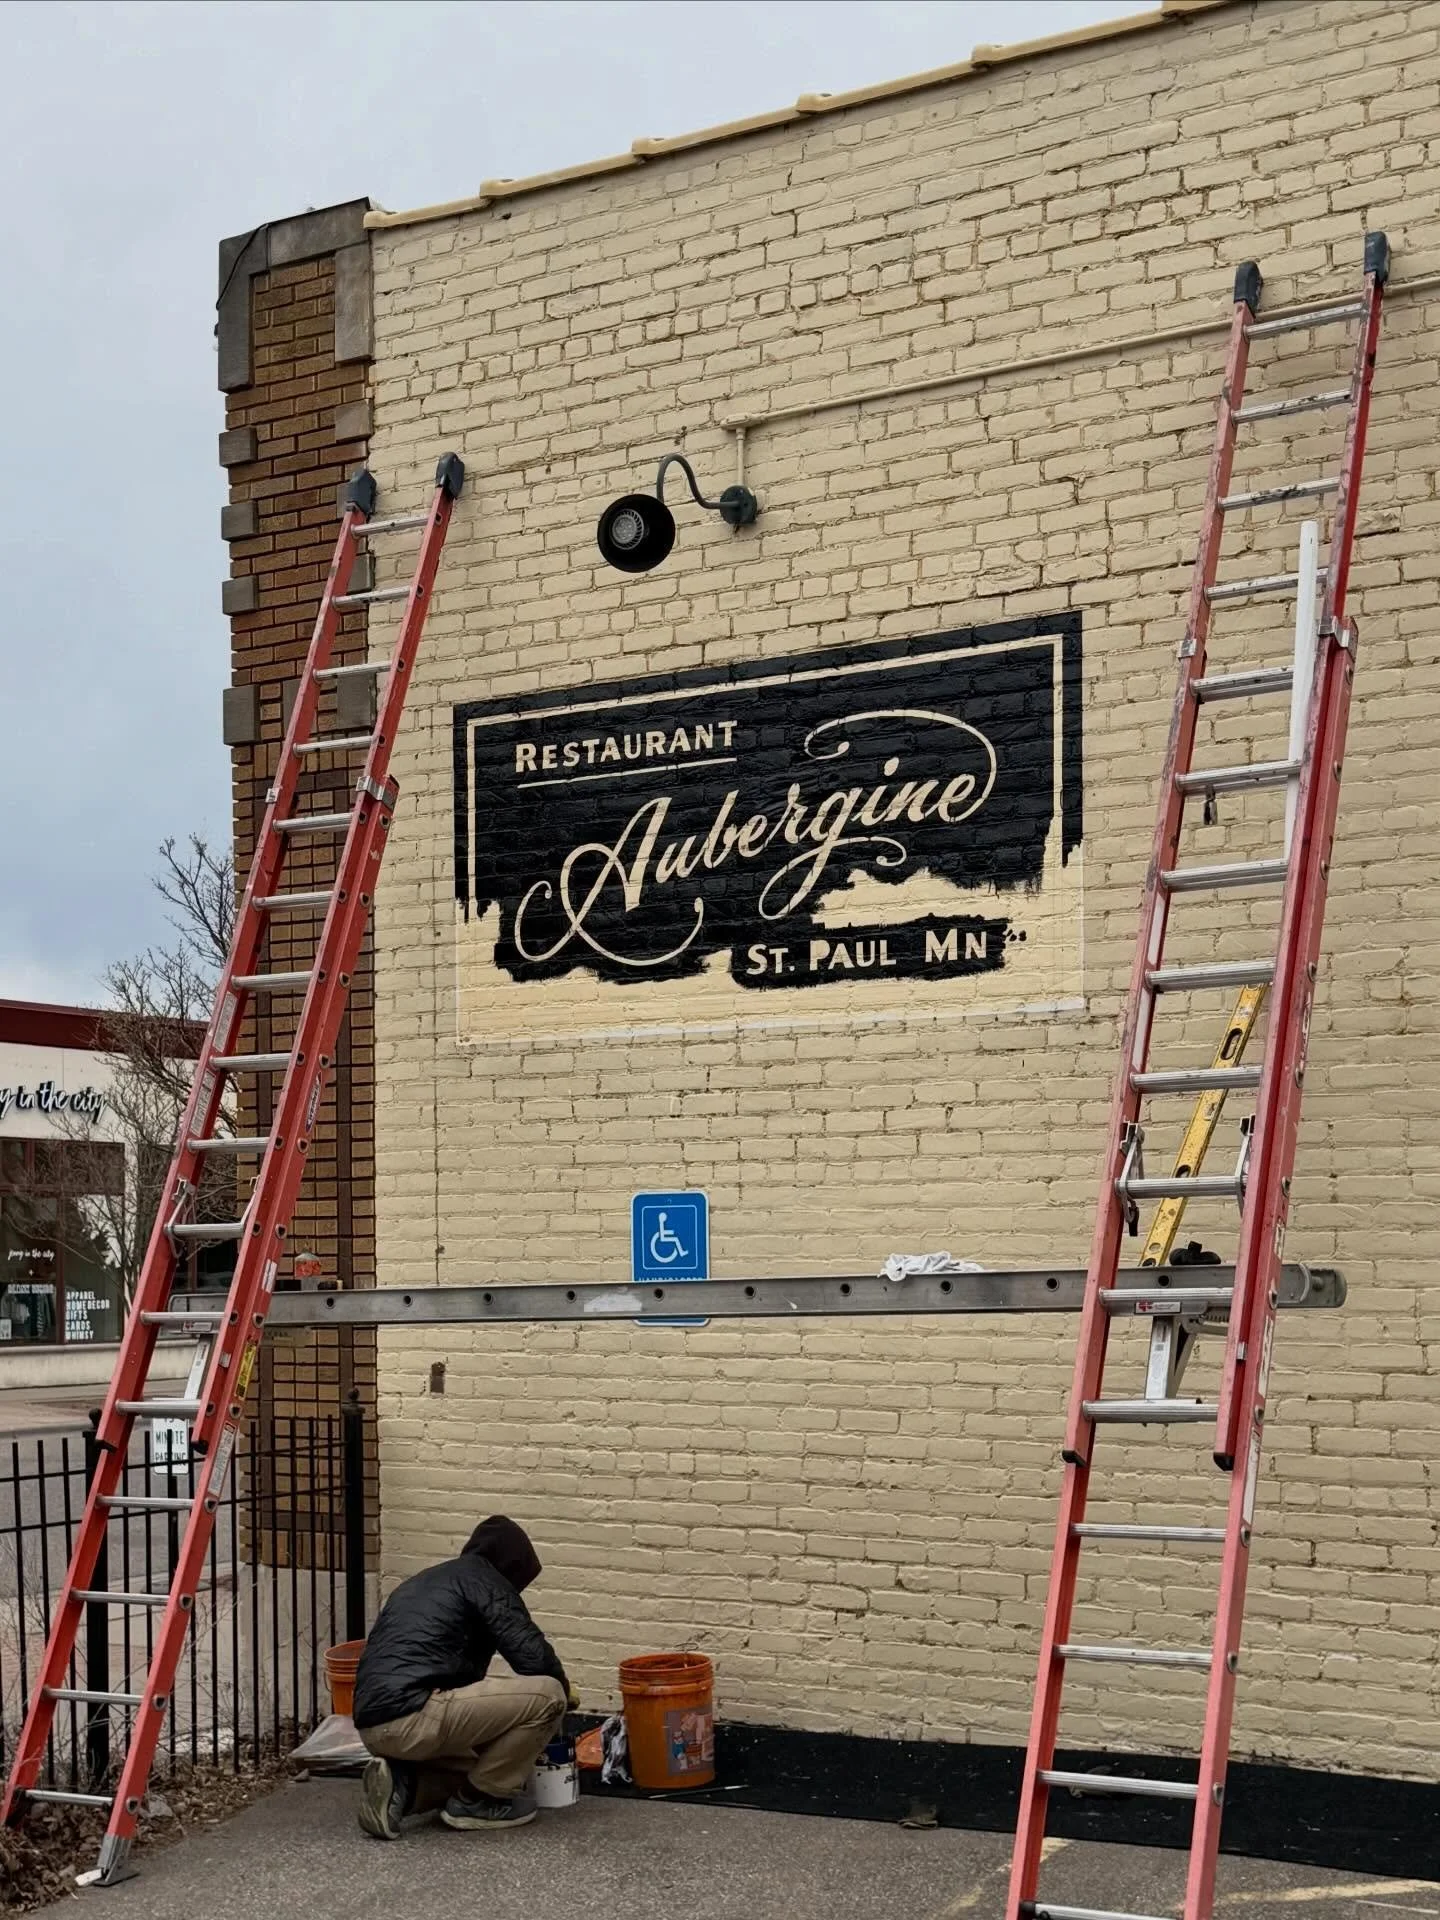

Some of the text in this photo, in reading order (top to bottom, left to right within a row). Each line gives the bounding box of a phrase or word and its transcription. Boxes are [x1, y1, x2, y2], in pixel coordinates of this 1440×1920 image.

[515, 720, 738, 773] RESTAURANT
[514, 708, 997, 967] Aubergine
[746, 928, 988, 975] ST. PAUL MN
[17, 1085, 35, 1109] in
[37, 1081, 69, 1113] the
[71, 1086, 108, 1125] city
[155, 1452, 186, 1465] PARING
